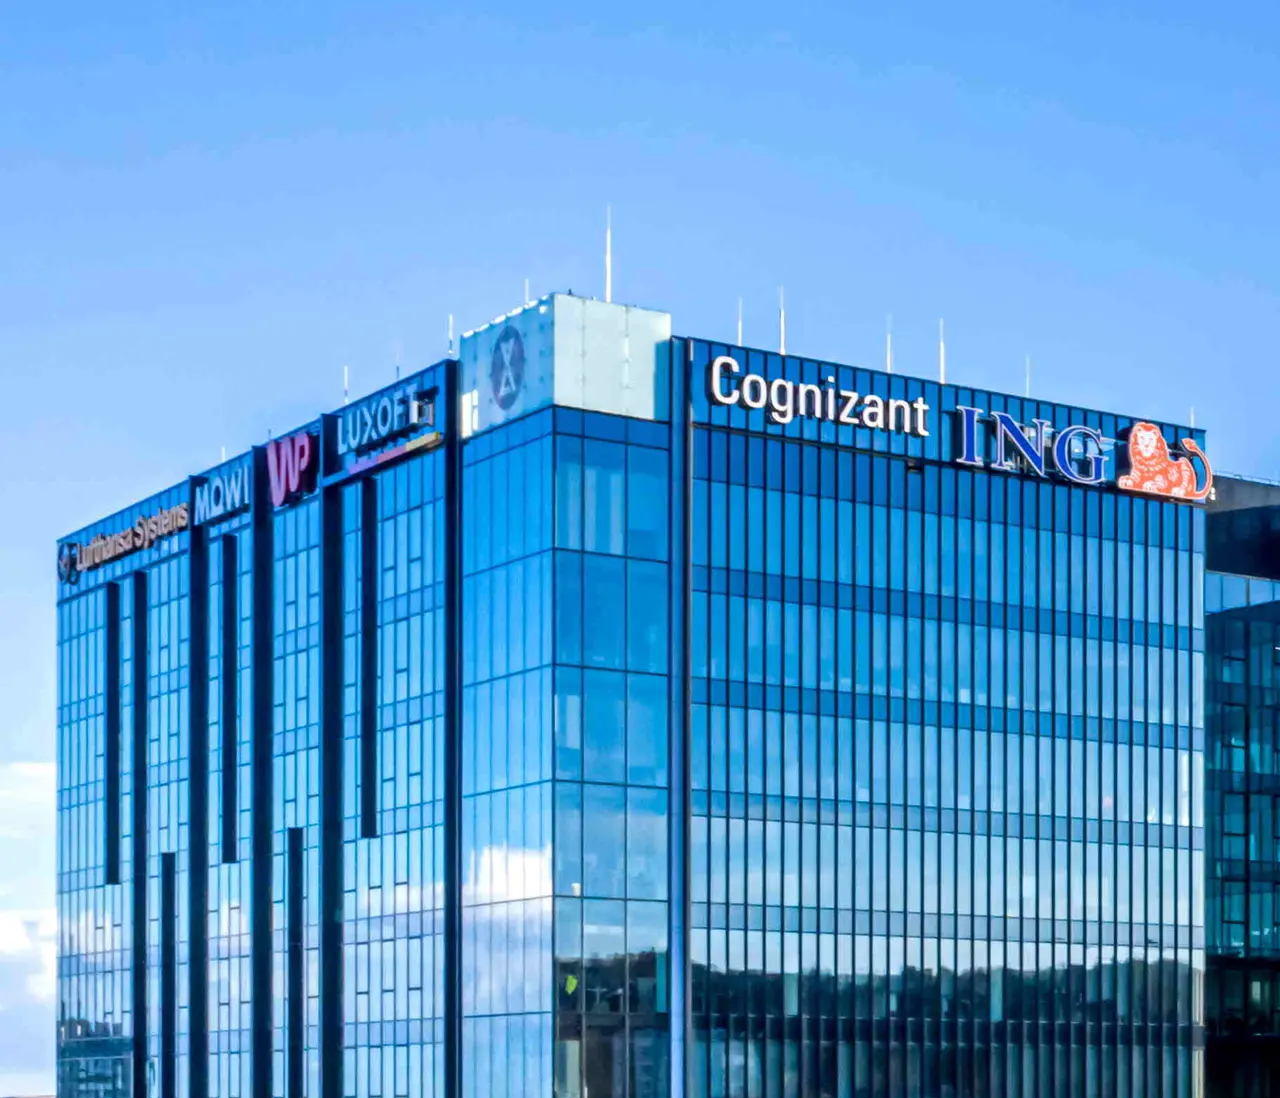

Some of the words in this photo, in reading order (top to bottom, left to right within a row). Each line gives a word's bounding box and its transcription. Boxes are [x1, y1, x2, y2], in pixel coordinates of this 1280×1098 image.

[337, 384, 420, 455] LUXOFT
[711, 355, 930, 437] Cognizant
[266, 433, 311, 507] WP
[955, 404, 1107, 484] ING
[194, 465, 250, 526] MOWI
